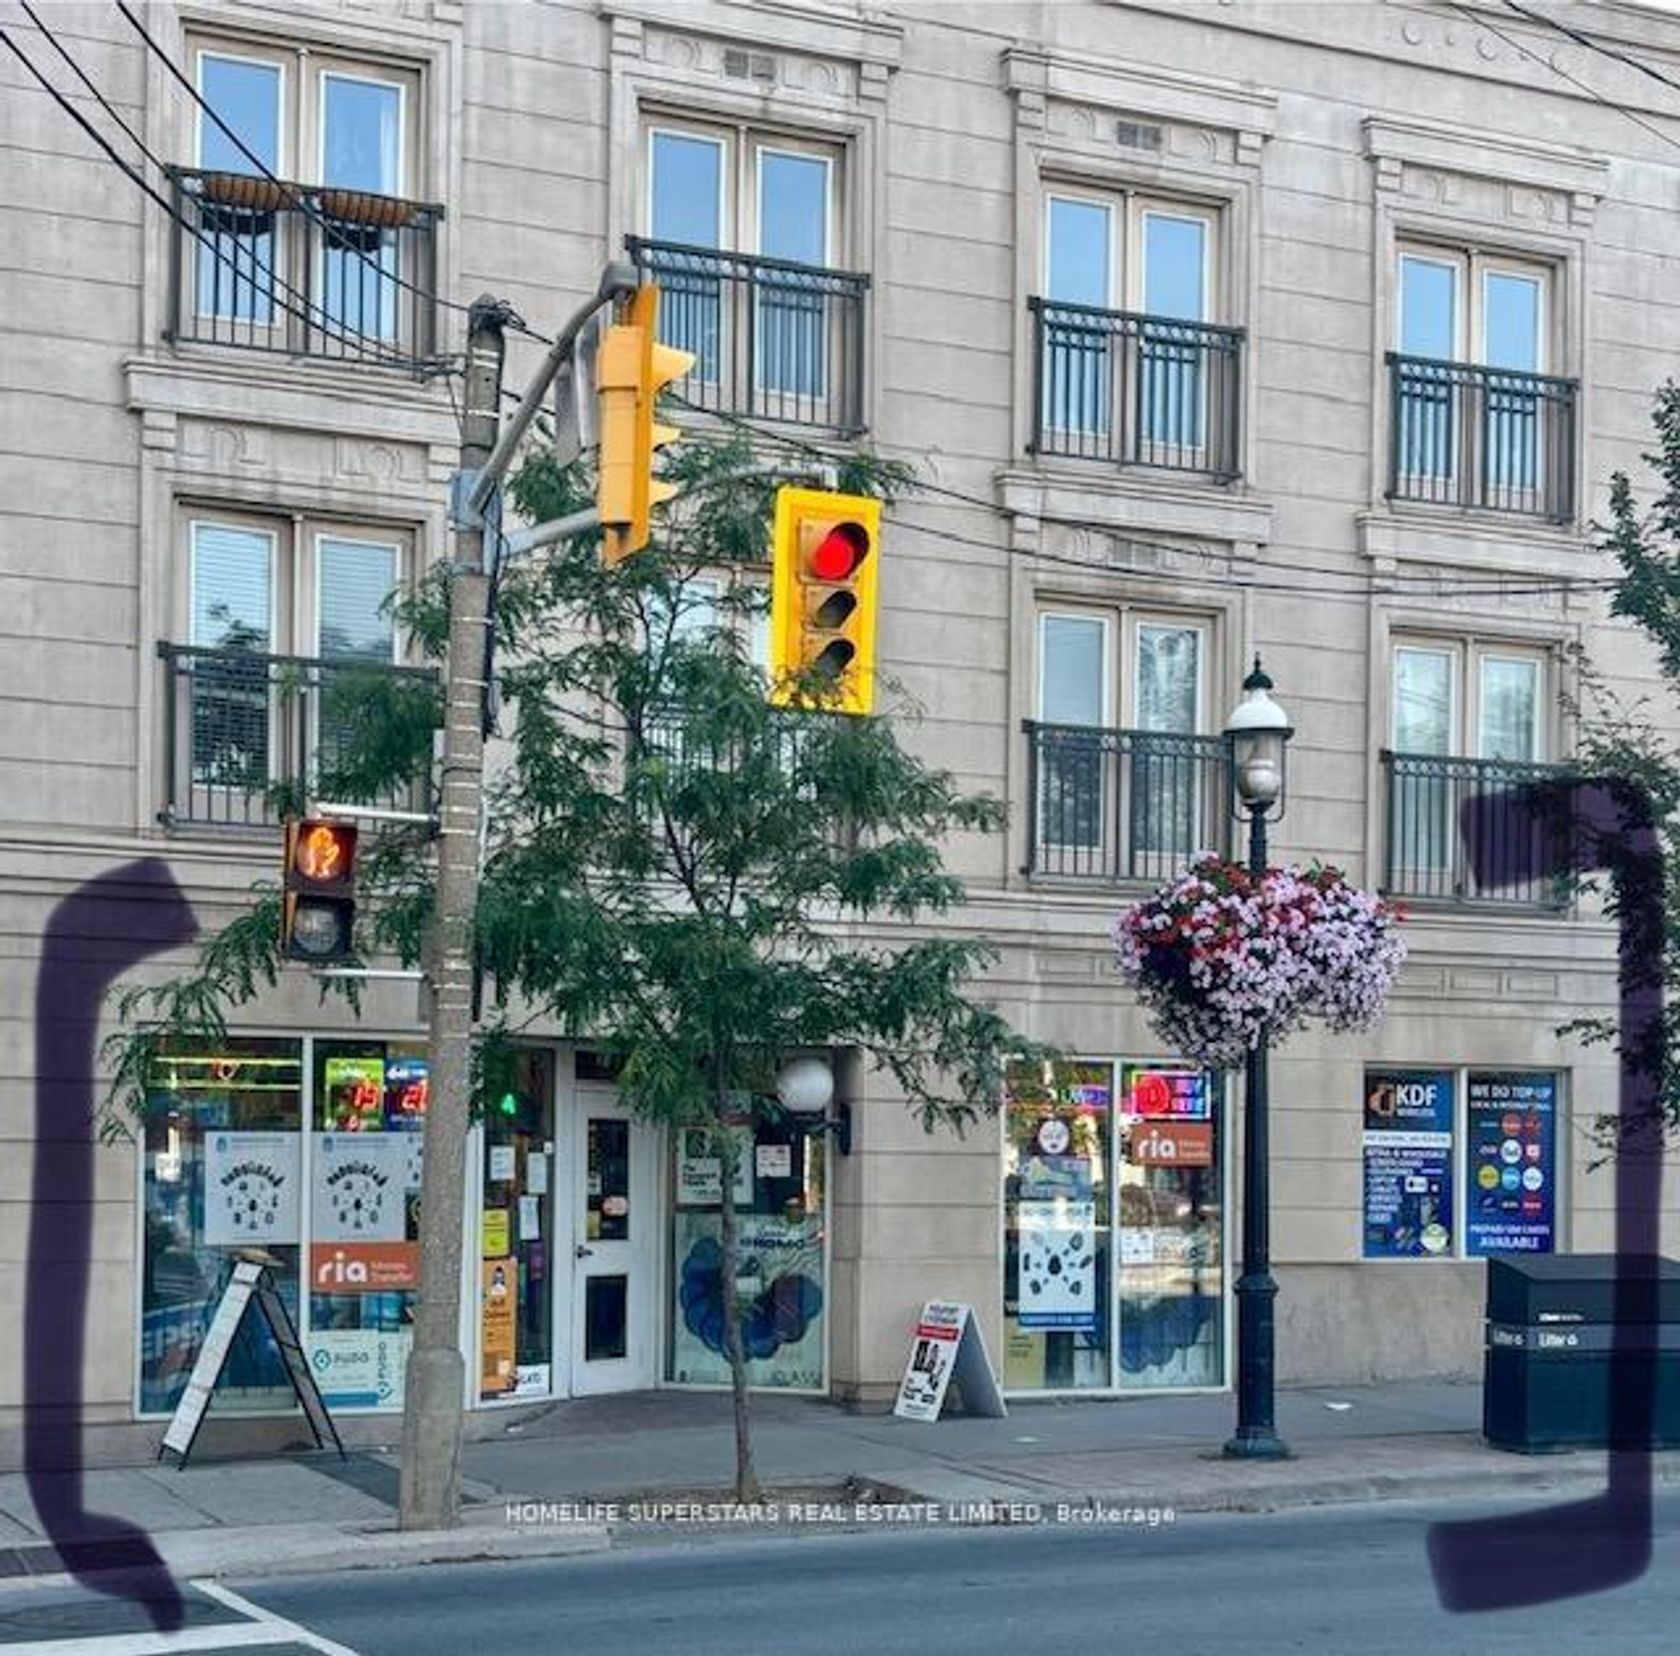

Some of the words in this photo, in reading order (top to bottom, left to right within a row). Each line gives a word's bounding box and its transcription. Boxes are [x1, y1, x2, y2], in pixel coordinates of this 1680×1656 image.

[1395, 1084, 1438, 1107] KDF
[1470, 1083, 1490, 1099] WE
[1491, 1084, 1511, 1099] DO
[1138, 1129, 1177, 1159] ria
[1478, 1236, 1540, 1249] AVAILABLE
[318, 1250, 368, 1283] ria
